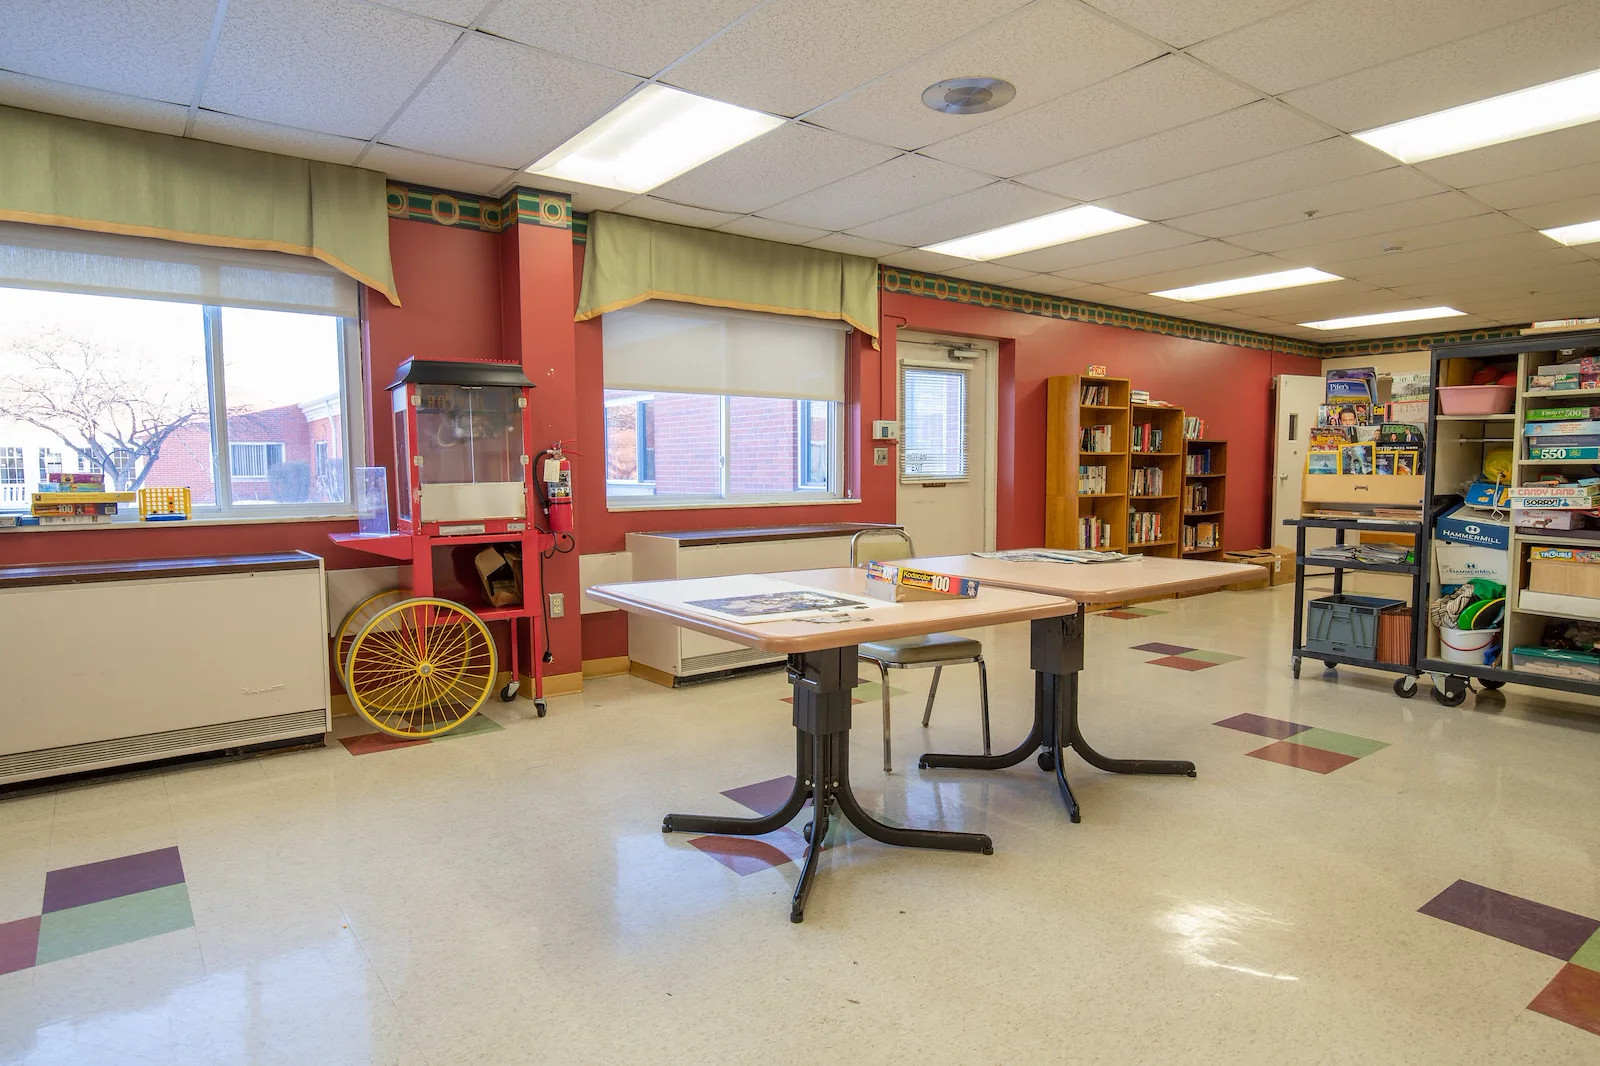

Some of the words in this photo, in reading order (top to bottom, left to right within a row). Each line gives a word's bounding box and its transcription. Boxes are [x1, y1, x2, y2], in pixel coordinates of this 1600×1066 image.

[1329, 383, 1350, 391] Pifer's
[1564, 409, 1581, 417] 500
[1541, 448, 1567, 459] 550
[1517, 488, 1548, 496] CANDY
[1551, 488, 1576, 496] LAND
[57, 504, 73, 513] 100
[1540, 550, 1573, 559] TROUBLE
[903, 570, 931, 581] Kodacolor
[931, 575, 950, 592] 100
